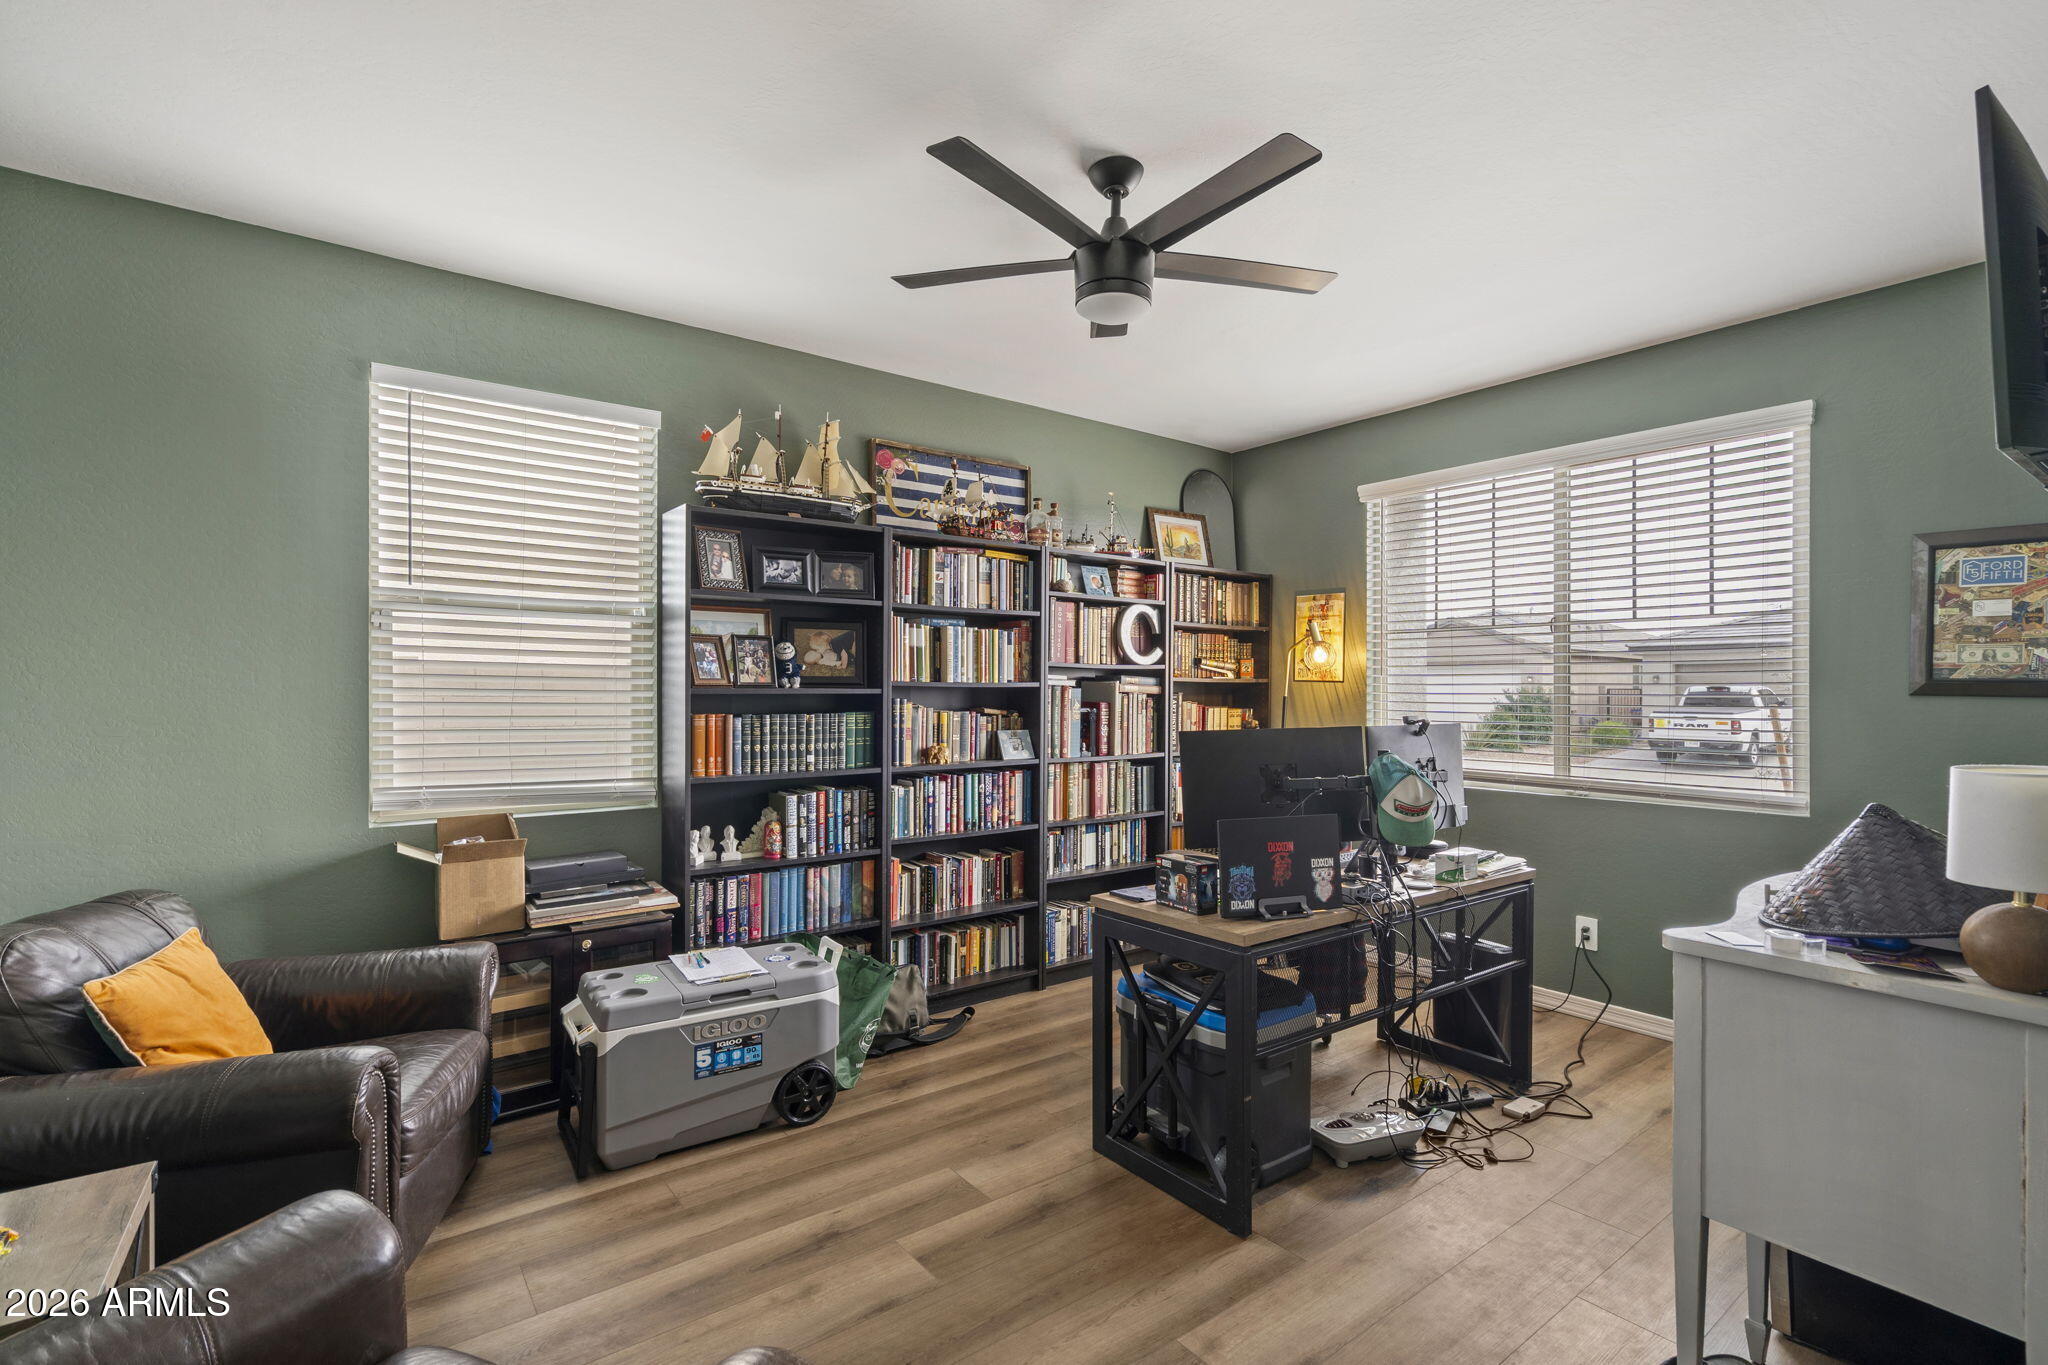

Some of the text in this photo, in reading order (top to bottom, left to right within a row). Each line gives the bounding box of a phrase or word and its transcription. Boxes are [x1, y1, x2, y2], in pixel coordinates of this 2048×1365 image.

[1982, 560, 2023, 570] FORD
[1982, 570, 2023, 580] FIFTH
[1120, 604, 1164, 665] C
[785, 662, 793, 674] 3
[1267, 841, 1294, 852] DIXXON
[1311, 858, 1334, 867] DIXXON
[694, 1014, 767, 1041] IGLOO
[716, 1038, 743, 1048] IGLOO
[696, 1048, 712, 1068] 5
